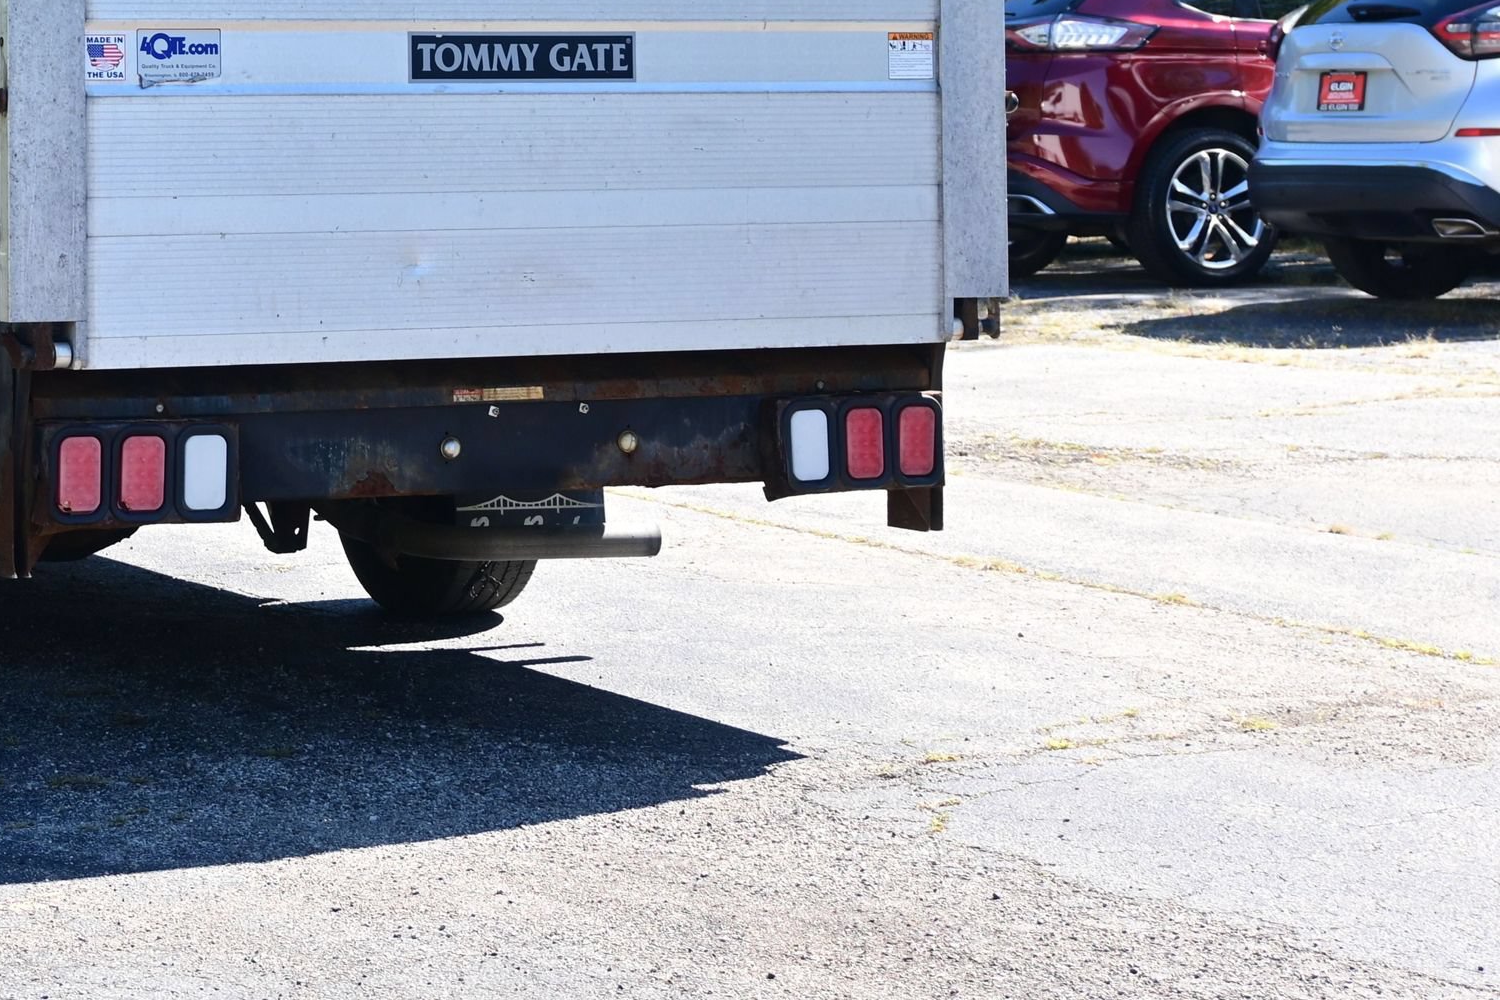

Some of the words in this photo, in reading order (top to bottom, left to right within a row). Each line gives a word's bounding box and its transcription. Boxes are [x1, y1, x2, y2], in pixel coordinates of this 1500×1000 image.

[417, 42, 540, 72] TOMMY
[549, 42, 629, 72] GATE
[1330, 81, 1354, 91] ELGIN
